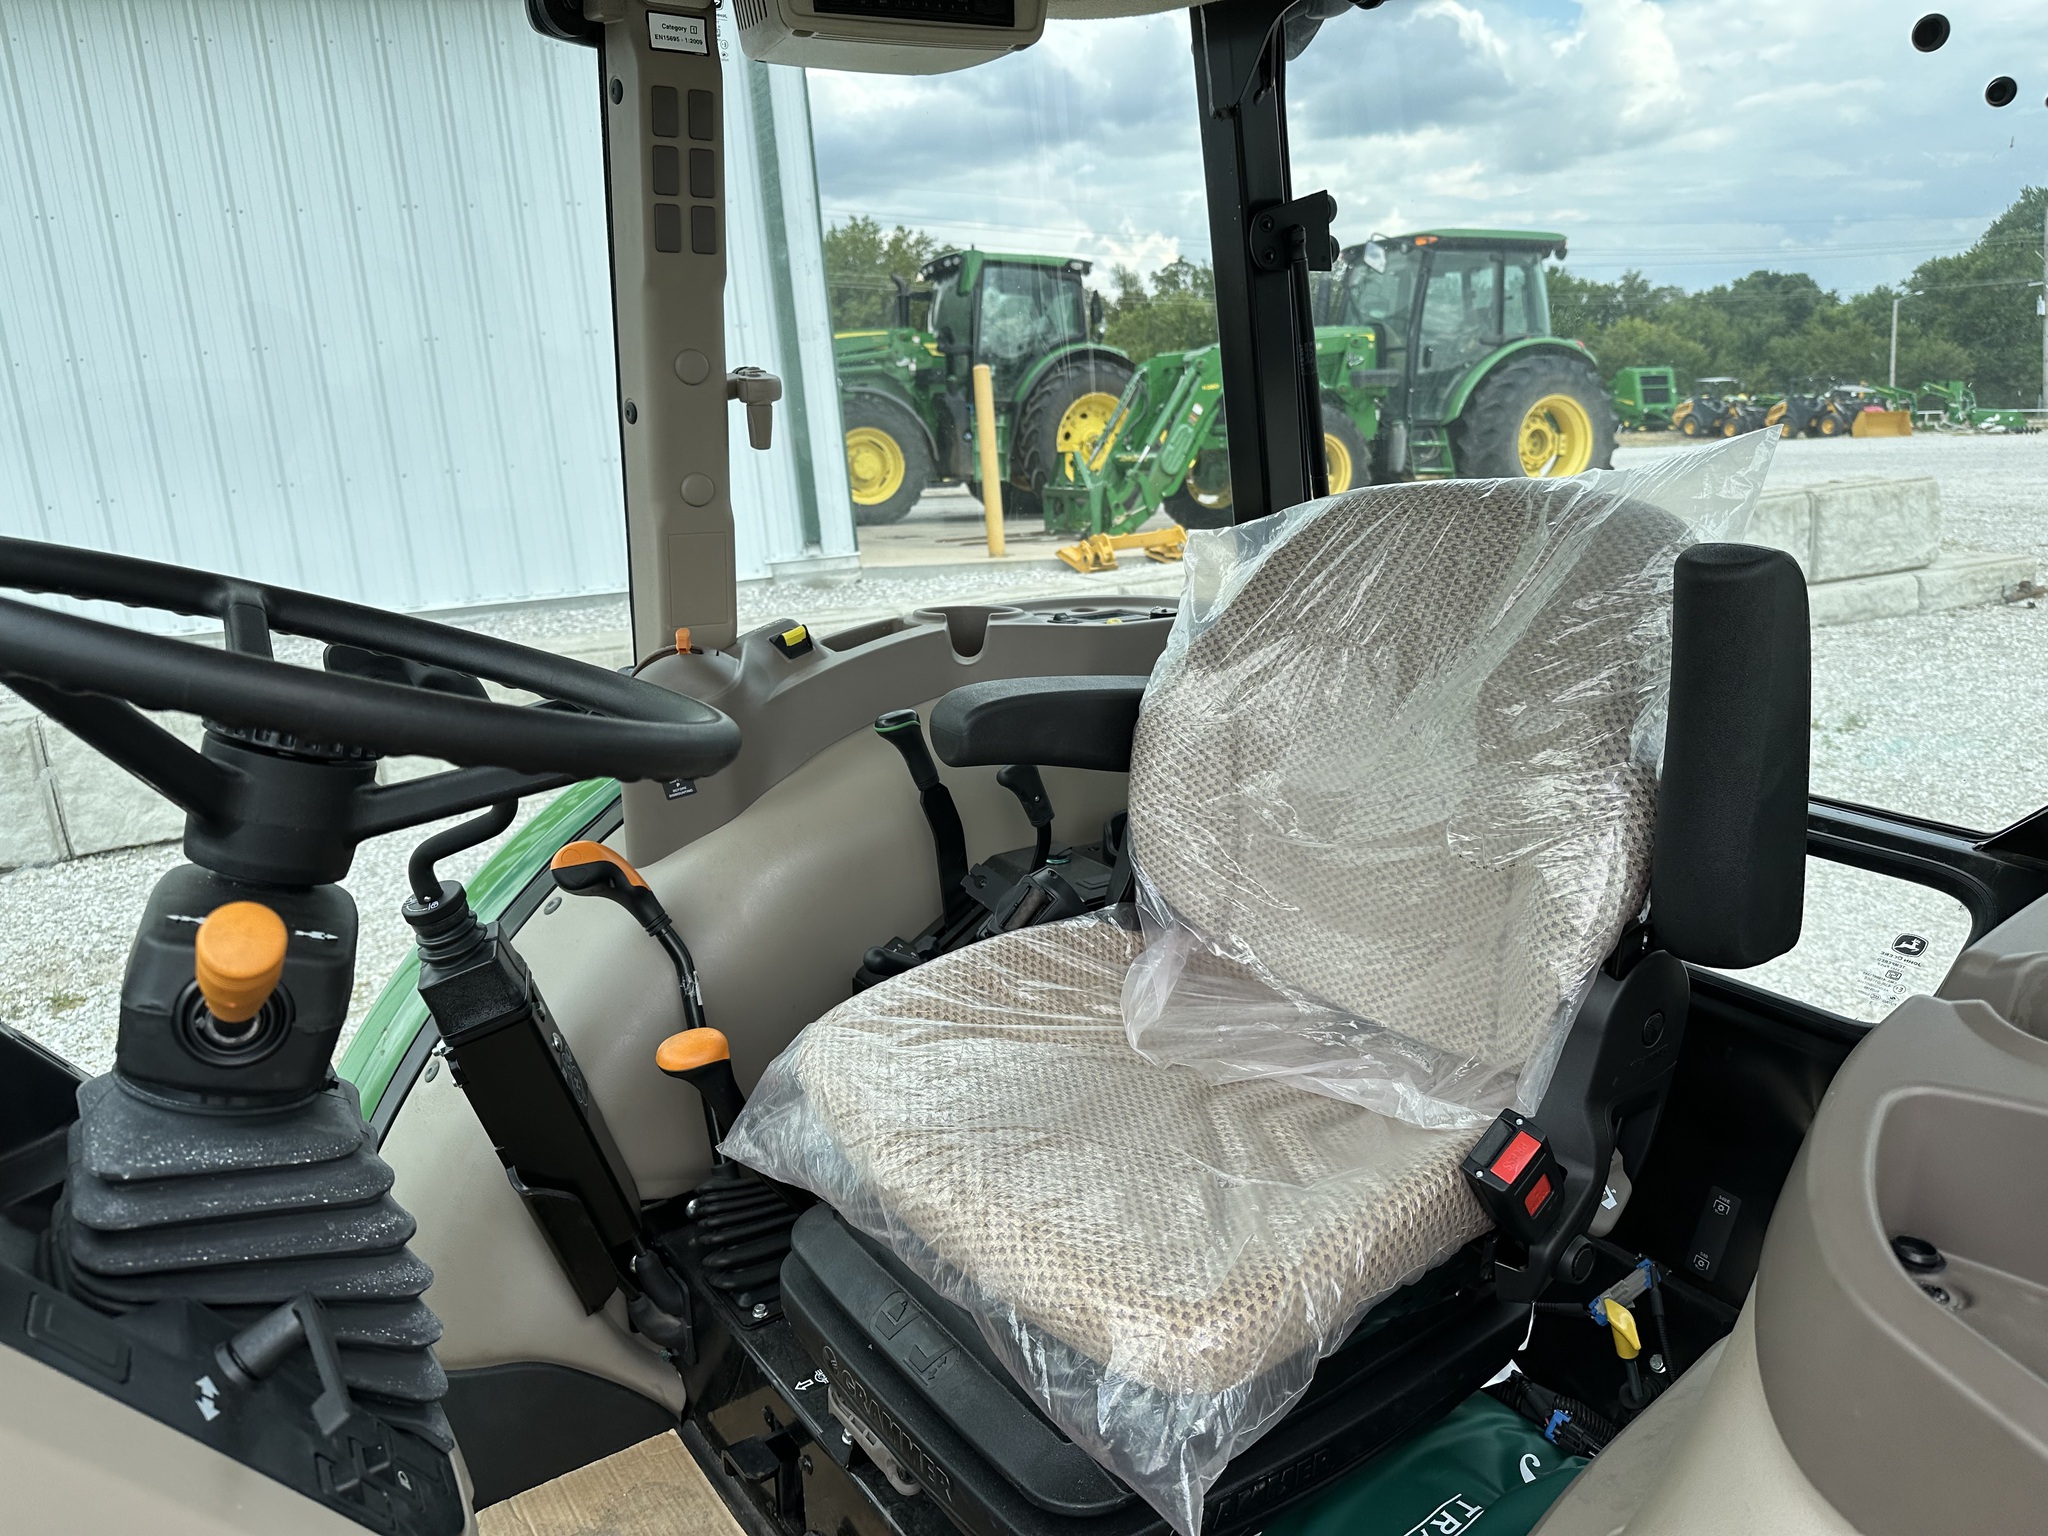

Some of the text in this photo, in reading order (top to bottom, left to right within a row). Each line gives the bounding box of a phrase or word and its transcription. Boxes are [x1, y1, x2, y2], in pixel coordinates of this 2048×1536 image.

[662, 24, 687, 33] Category
[1503, 1142, 1528, 1170] PRESS
[843, 1369, 953, 1503] GRAMMER
